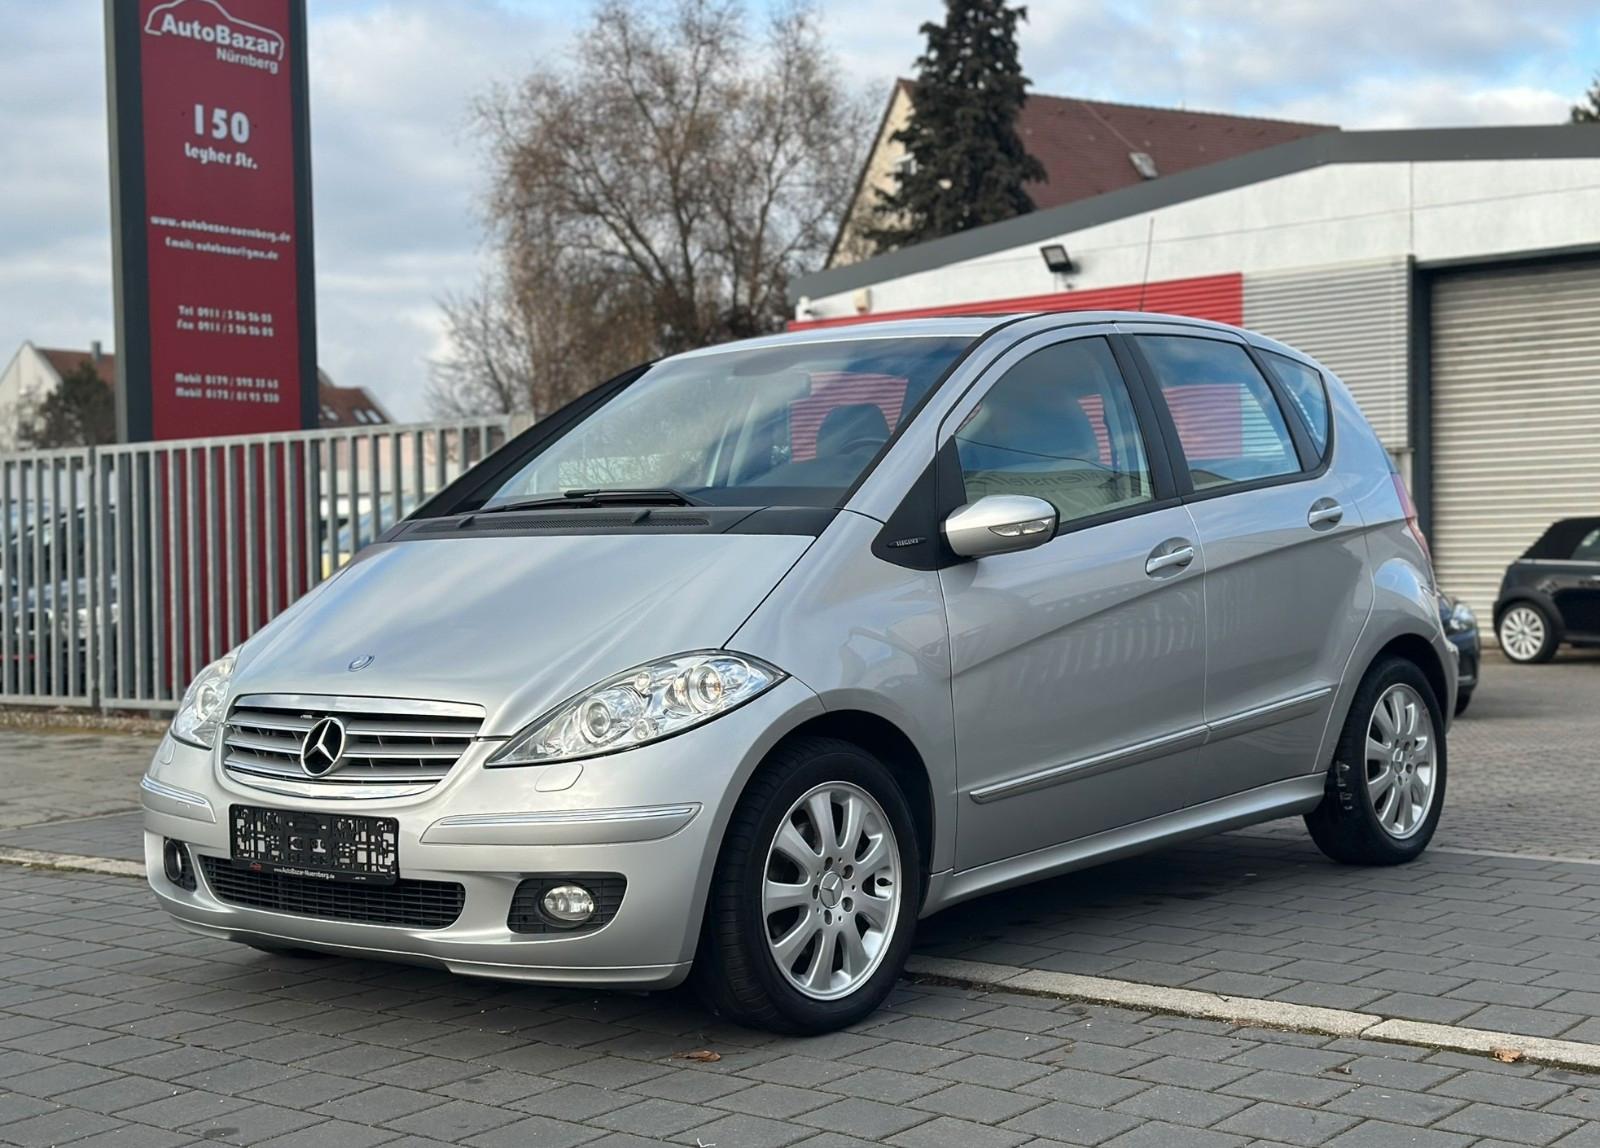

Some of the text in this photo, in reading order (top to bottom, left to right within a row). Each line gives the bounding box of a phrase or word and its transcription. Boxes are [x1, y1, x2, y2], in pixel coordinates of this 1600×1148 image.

[161, 13, 279, 55] AutoBazar
[217, 47, 278, 75] Nürnberg
[195, 104, 249, 143] 150
[185, 142, 232, 164] Leyher
[178, 305, 194, 317] Tel
